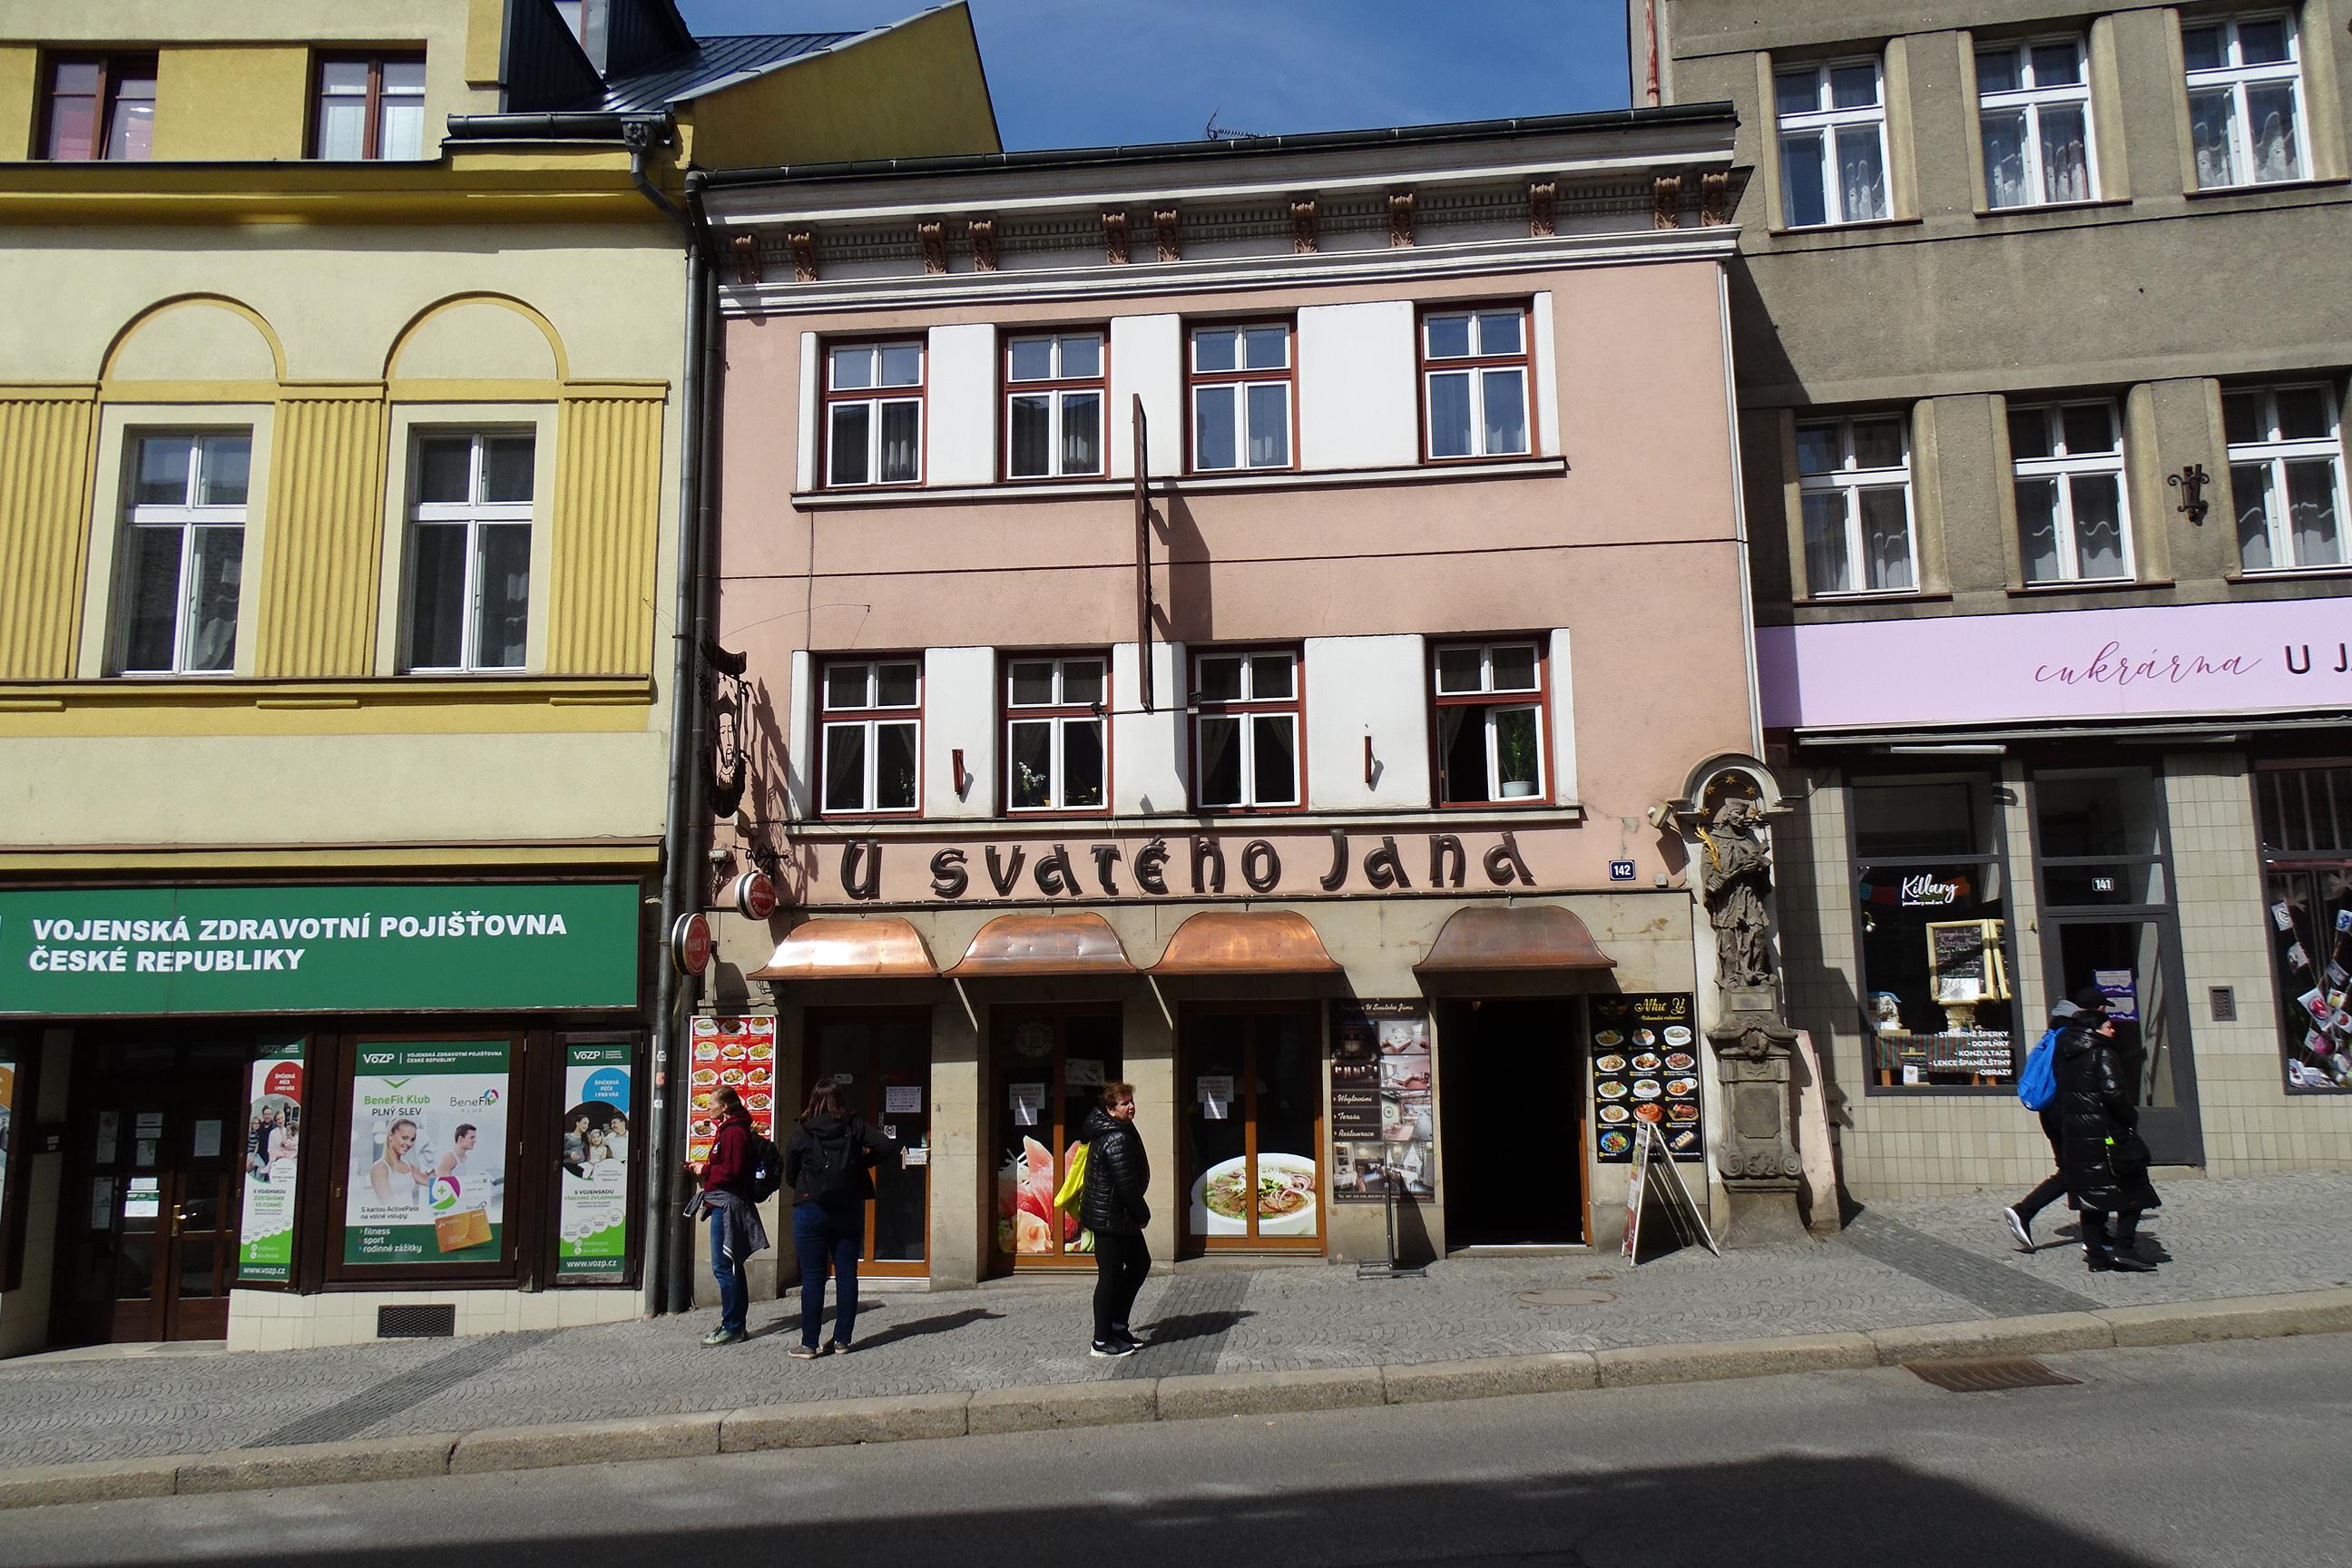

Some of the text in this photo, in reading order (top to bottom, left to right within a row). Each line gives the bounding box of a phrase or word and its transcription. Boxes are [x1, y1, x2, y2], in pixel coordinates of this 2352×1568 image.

[2035, 641, 2352, 686] cukrárna U J
[840, 838, 880, 897] U
[1613, 865, 1632, 876] 142
[1901, 873, 1959, 904] Killary
[2094, 879, 2112, 889] 141
[33, 910, 567, 941] VOJENSKÁ ZDRAVOTNÍ POJIŠŤOVNA
[29, 946, 306, 972] ČESKÉ REPUBLIKY
[1971, 1038, 2010, 1047] DOPLŇKY
[1959, 1058, 2011, 1066] ŠPANĚLŠTINY
[364, 1094, 430, 1105] BeneFit Klub
[450, 1096, 492, 1106] BeneFit
[372, 1106, 422, 1116] PLNÝ SLEV
[364, 1227, 391, 1235] fitness
[363, 1236, 385, 1245] sport
[363, 1244, 393, 1253] rodinné
[566, 1259, 618, 1269] www.vozp.cz
